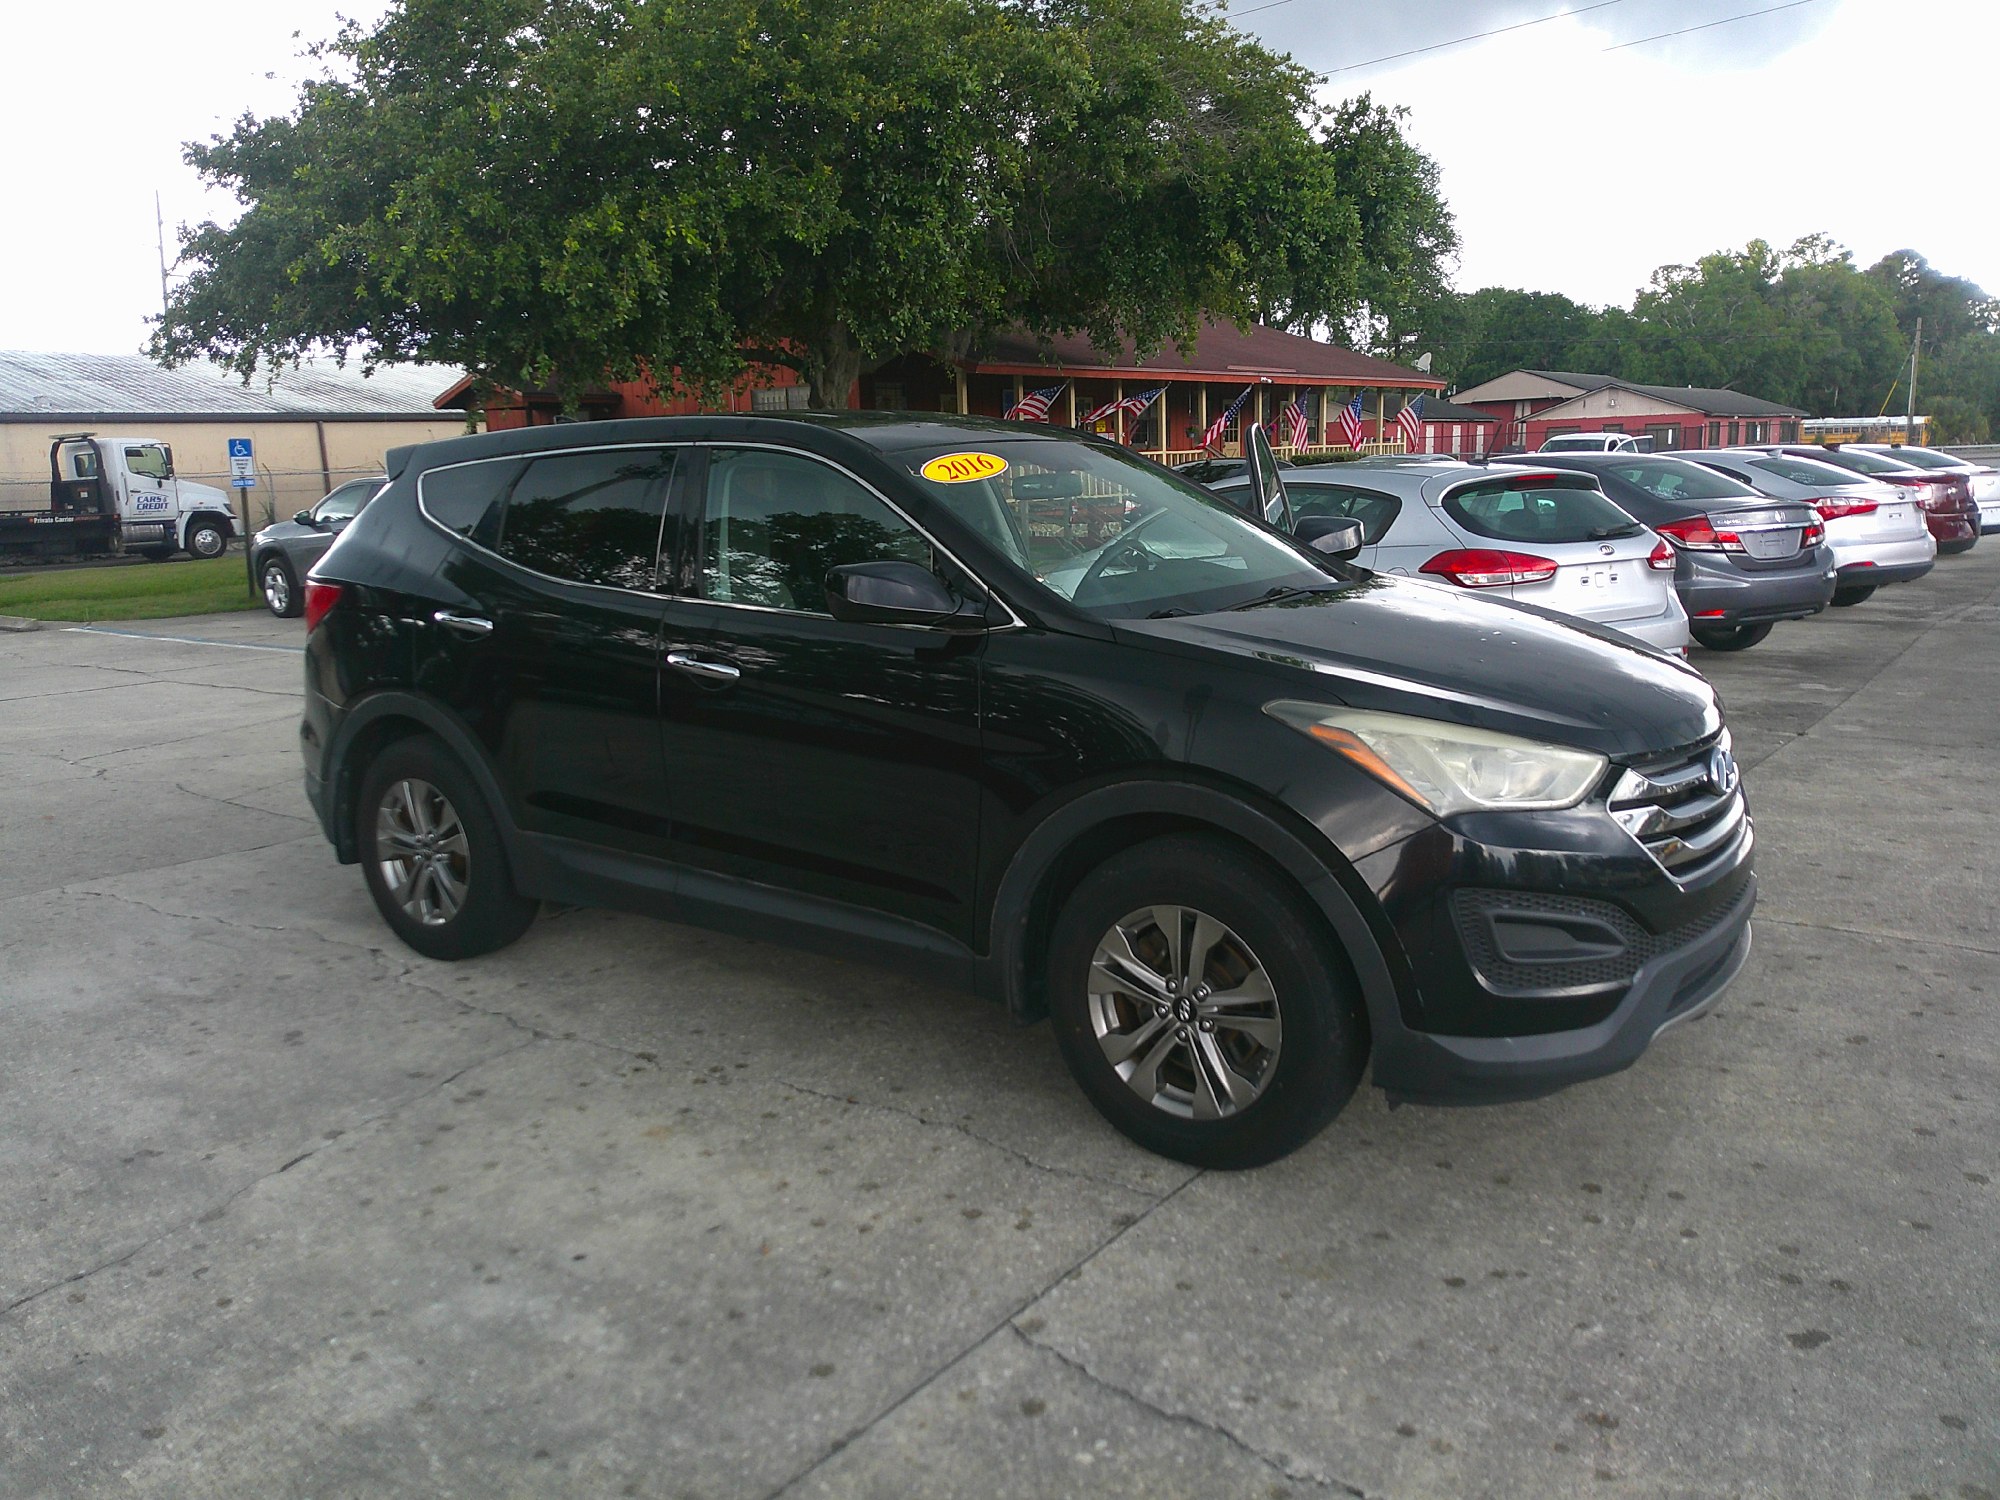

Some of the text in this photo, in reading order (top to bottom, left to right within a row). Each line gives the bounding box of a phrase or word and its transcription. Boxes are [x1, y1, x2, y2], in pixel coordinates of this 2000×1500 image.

[938, 454, 994, 480] 2016
[137, 495, 161, 503] CARS
[137, 502, 168, 510] CREDIT
